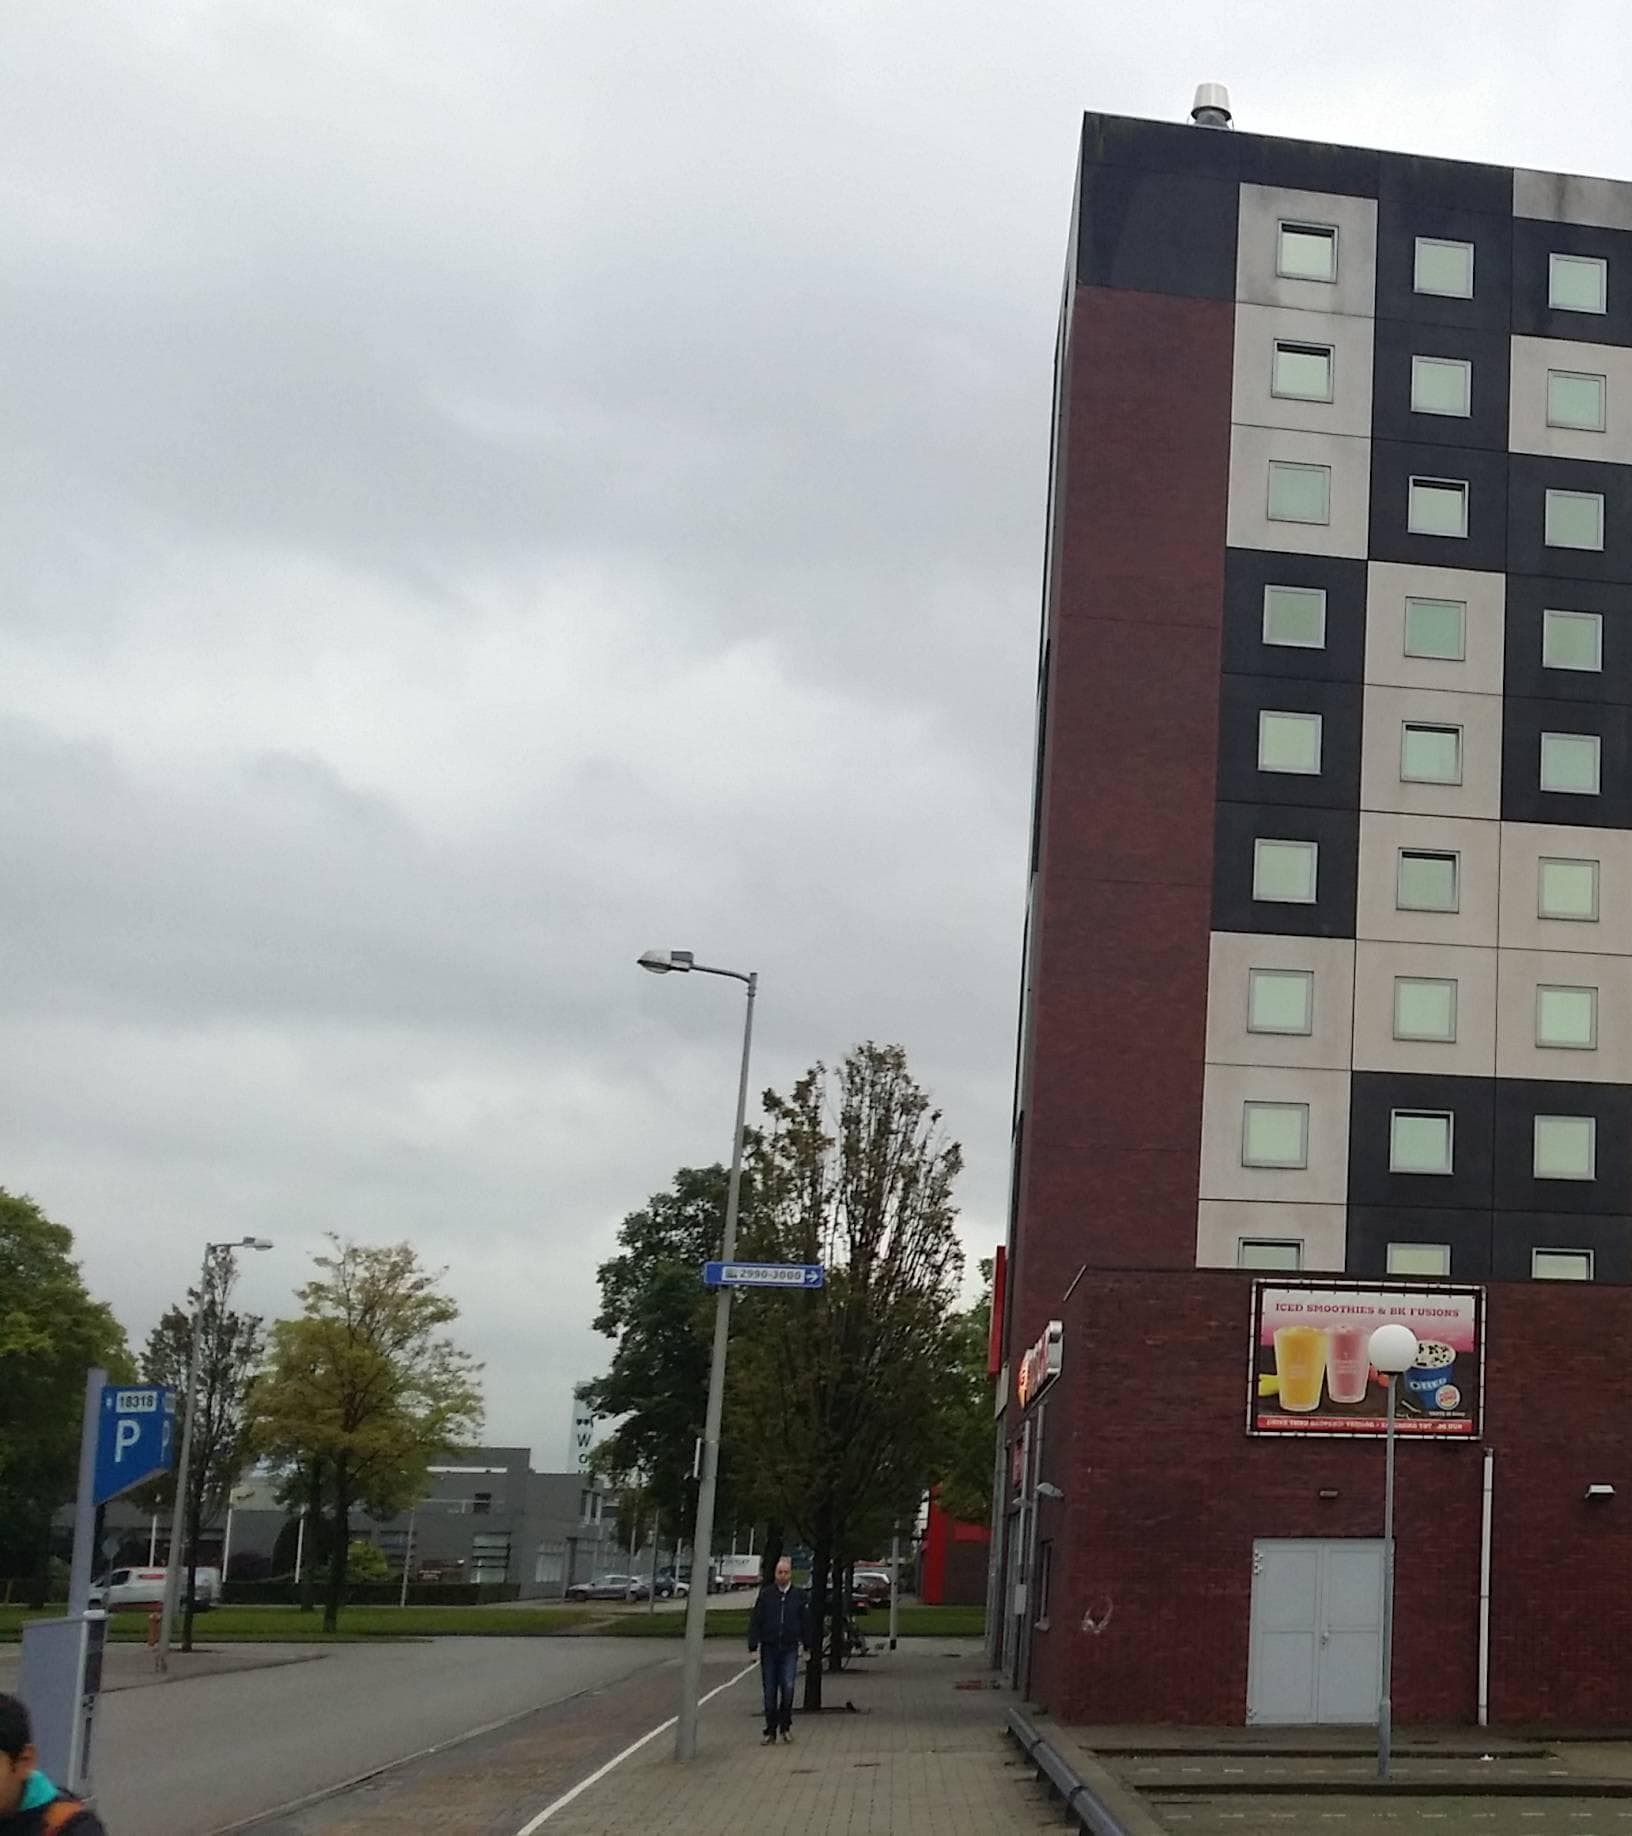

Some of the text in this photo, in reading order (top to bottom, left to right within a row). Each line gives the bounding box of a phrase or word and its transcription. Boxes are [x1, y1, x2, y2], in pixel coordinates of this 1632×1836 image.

[740, 1269, 801, 1280] 2990-3000
[1275, 1303, 1303, 1312] ICED
[1306, 1303, 1375, 1315] SMOOTHIES
[1390, 1307, 1406, 1316] BK
[1410, 1308, 1459, 1317] FUSIONS
[120, 1396, 154, 1408] 18318
[115, 1420, 140, 1462] P
